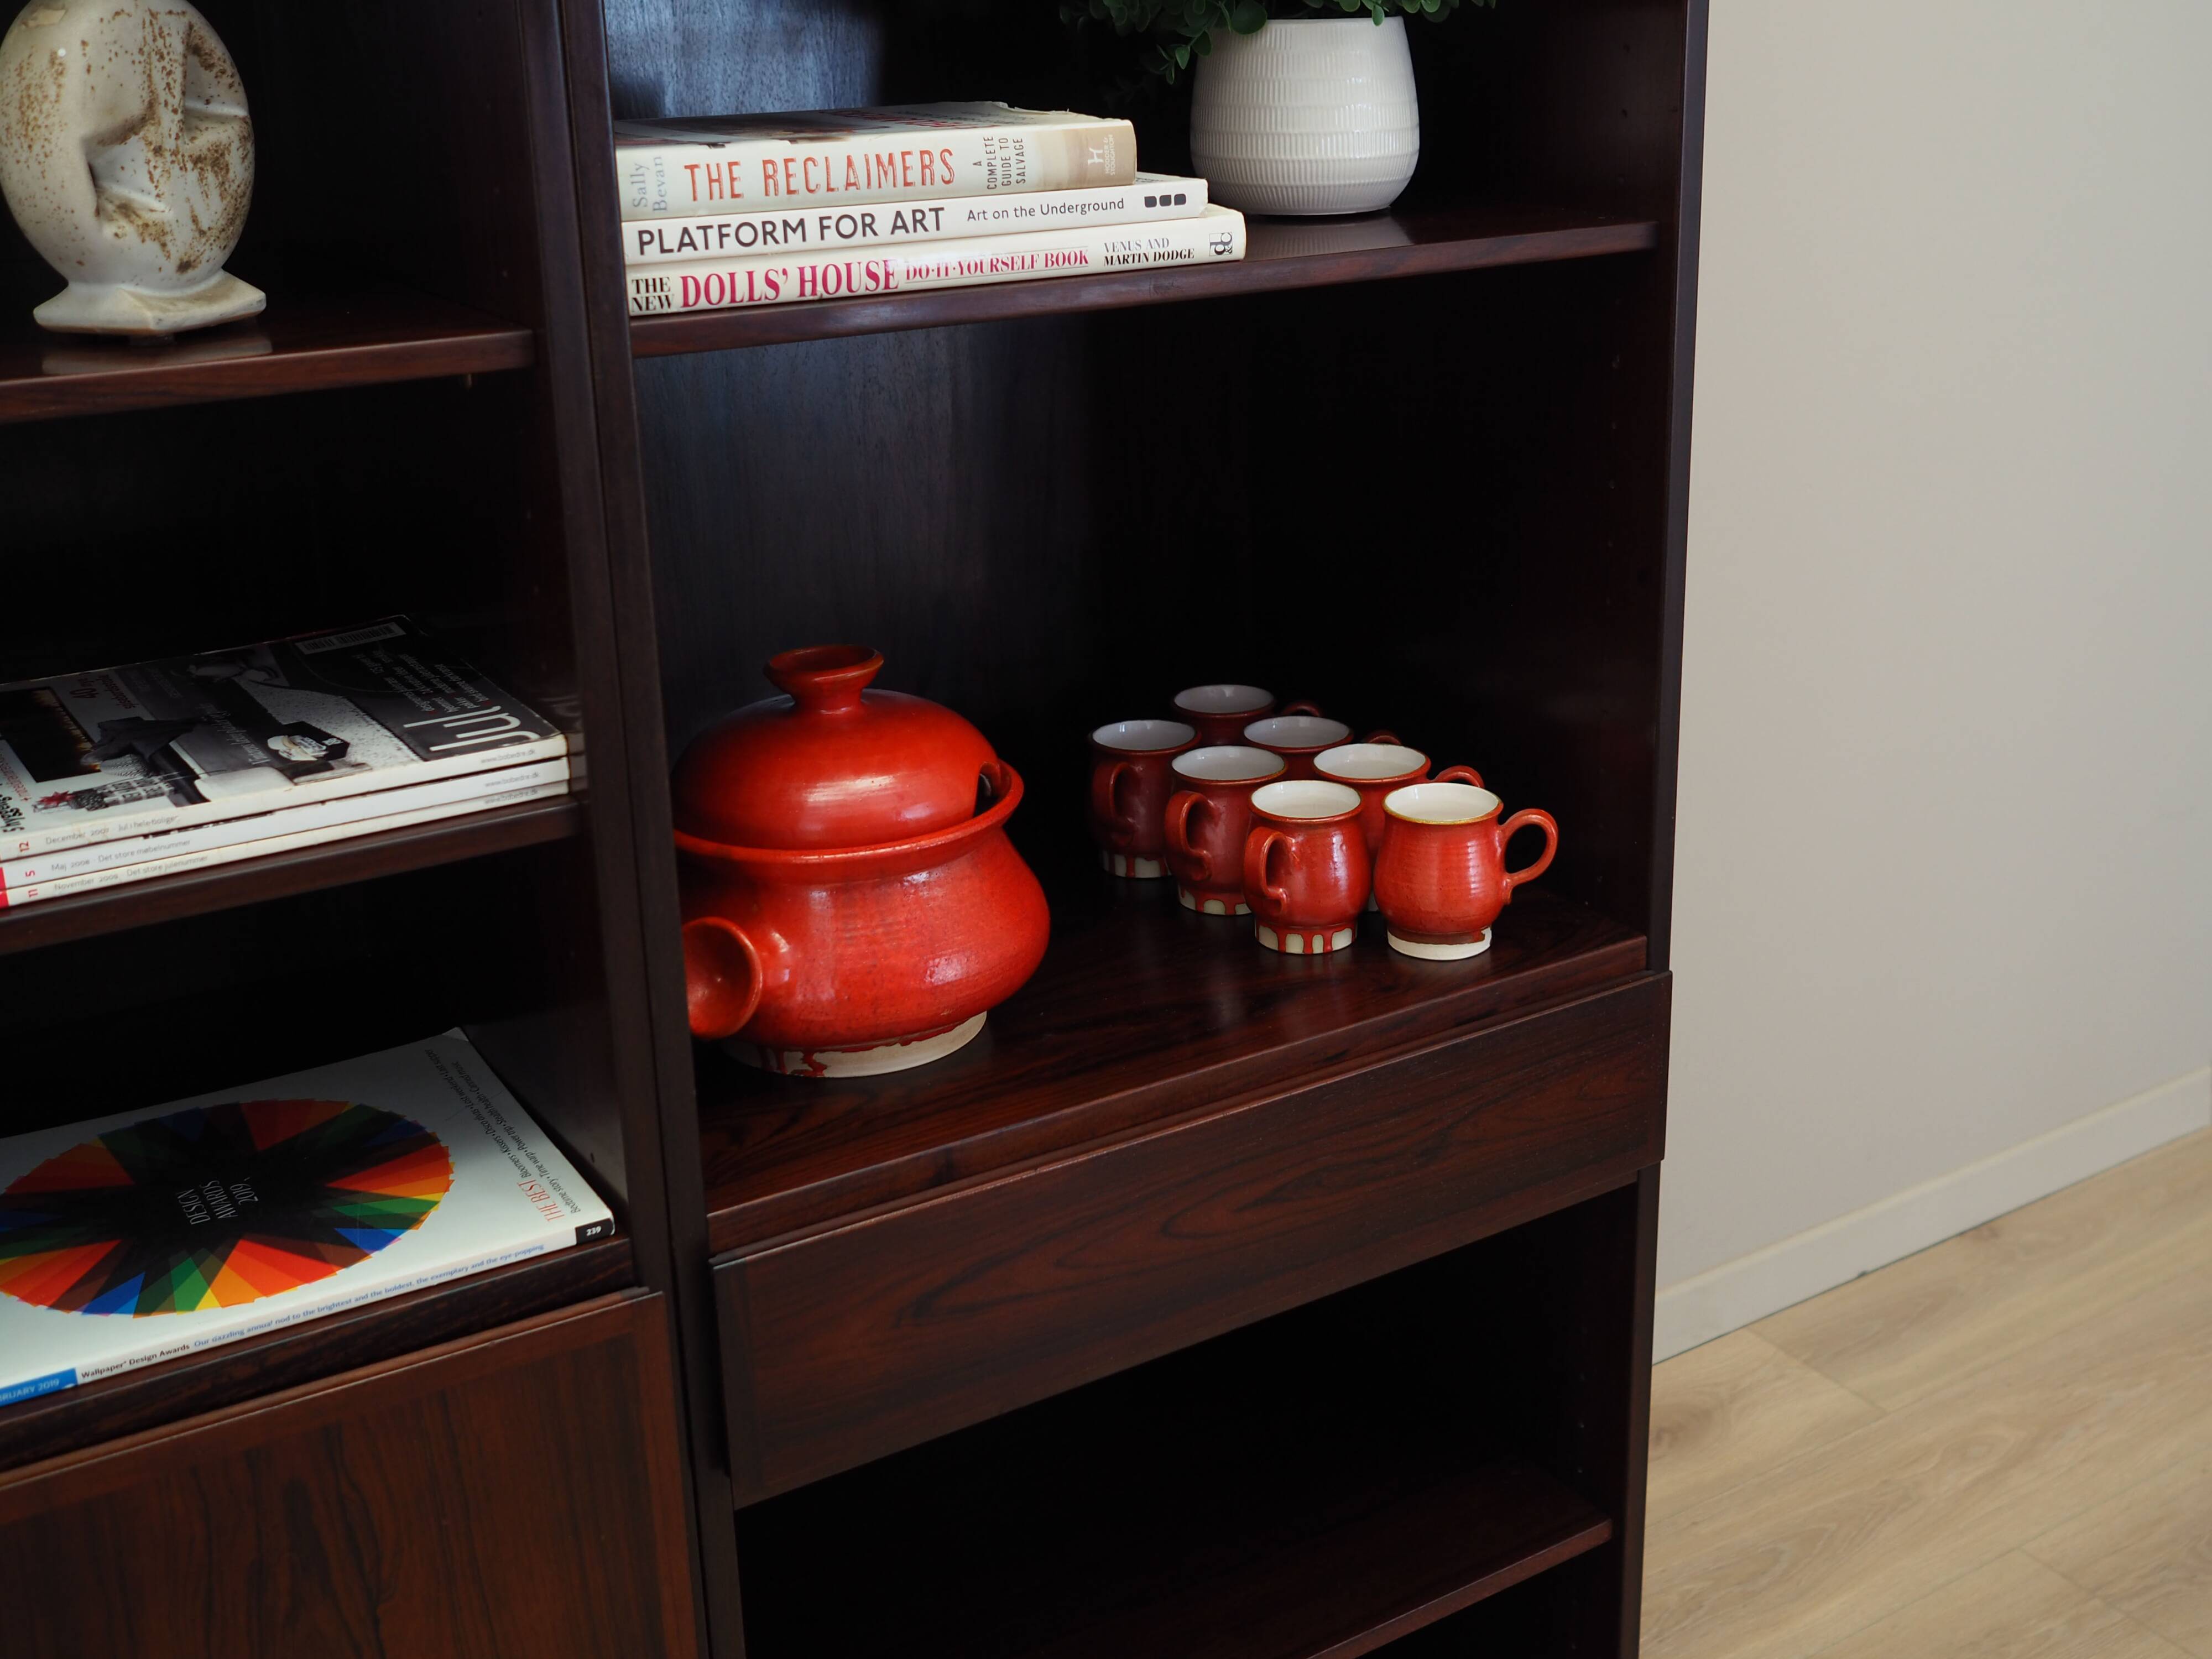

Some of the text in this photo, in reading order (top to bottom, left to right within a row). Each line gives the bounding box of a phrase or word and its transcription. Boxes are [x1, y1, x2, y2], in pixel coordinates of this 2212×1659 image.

[684, 148, 954, 201] THE RECLAIMERS
[984, 136, 998, 189] COMPLETE
[999, 137, 1011, 186] GUIDE TO
[1013, 137, 1026, 184] SALVAGE
[629, 163, 650, 207] Sally
[653, 156, 667, 211] Bevan
[967, 197, 1125, 222] Art on the Underground
[638, 207, 945, 255] PLATFORM FOR ART
[1104, 237, 1170, 253] VENUS AND
[797, 258, 899, 298] HOUSE
[1044, 250, 1089, 268] BOOK
[1104, 248, 1194, 267] MARTIN DODGE
[632, 276, 671, 295] THE
[632, 294, 674, 313] NEW
[19, 841, 30, 852] 12
[46, 831, 85, 844] December
[52, 863, 67, 872] Maj
[98, 854, 112, 863] Det
[114, 849, 135, 859] store
[137, 839, 191, 855] møbelnummer
[55, 878, 95, 891] November
[127, 868, 142, 877] Det
[143, 863, 164, 874] store
[164, 855, 209, 873] julenummer
[28, 889, 38, 898] 11
[425, 1048, 565, 1222] THE BEST Bloomers Kissers Disco divas Lost weekend Last supper
[451, 1061, 581, 1214] Bedtime story Time warp Power trip Stealth health Canned music
[175, 1188, 211, 1225] DESIGN
[199, 1180, 239, 1219] AWARDS
[586, 1225, 602, 1237] 239
[0, 1383, 35, 1401] RUARY
[37, 1379, 60, 1391] 2019
[129, 1353, 157, 1366] Design
[159, 1345, 190, 1357] Awards
[194, 1338, 211, 1347] Our
[212, 1328, 245, 1343] dazzling
[247, 1320, 273, 1333] annual
[275, 1316, 291, 1325] nod
[303, 1308, 316, 1317] the
[317, 1298, 352, 1314] brightest
[354, 1293, 369, 1302] and
[371, 1290, 383, 1298] the
[416, 1276, 429, 1285] the
[430, 1265, 469, 1281] exemplary
[471, 1260, 484, 1270] and
[486, 1256, 498, 1265] the
[499, 1243, 545, 1261] eye-popping
